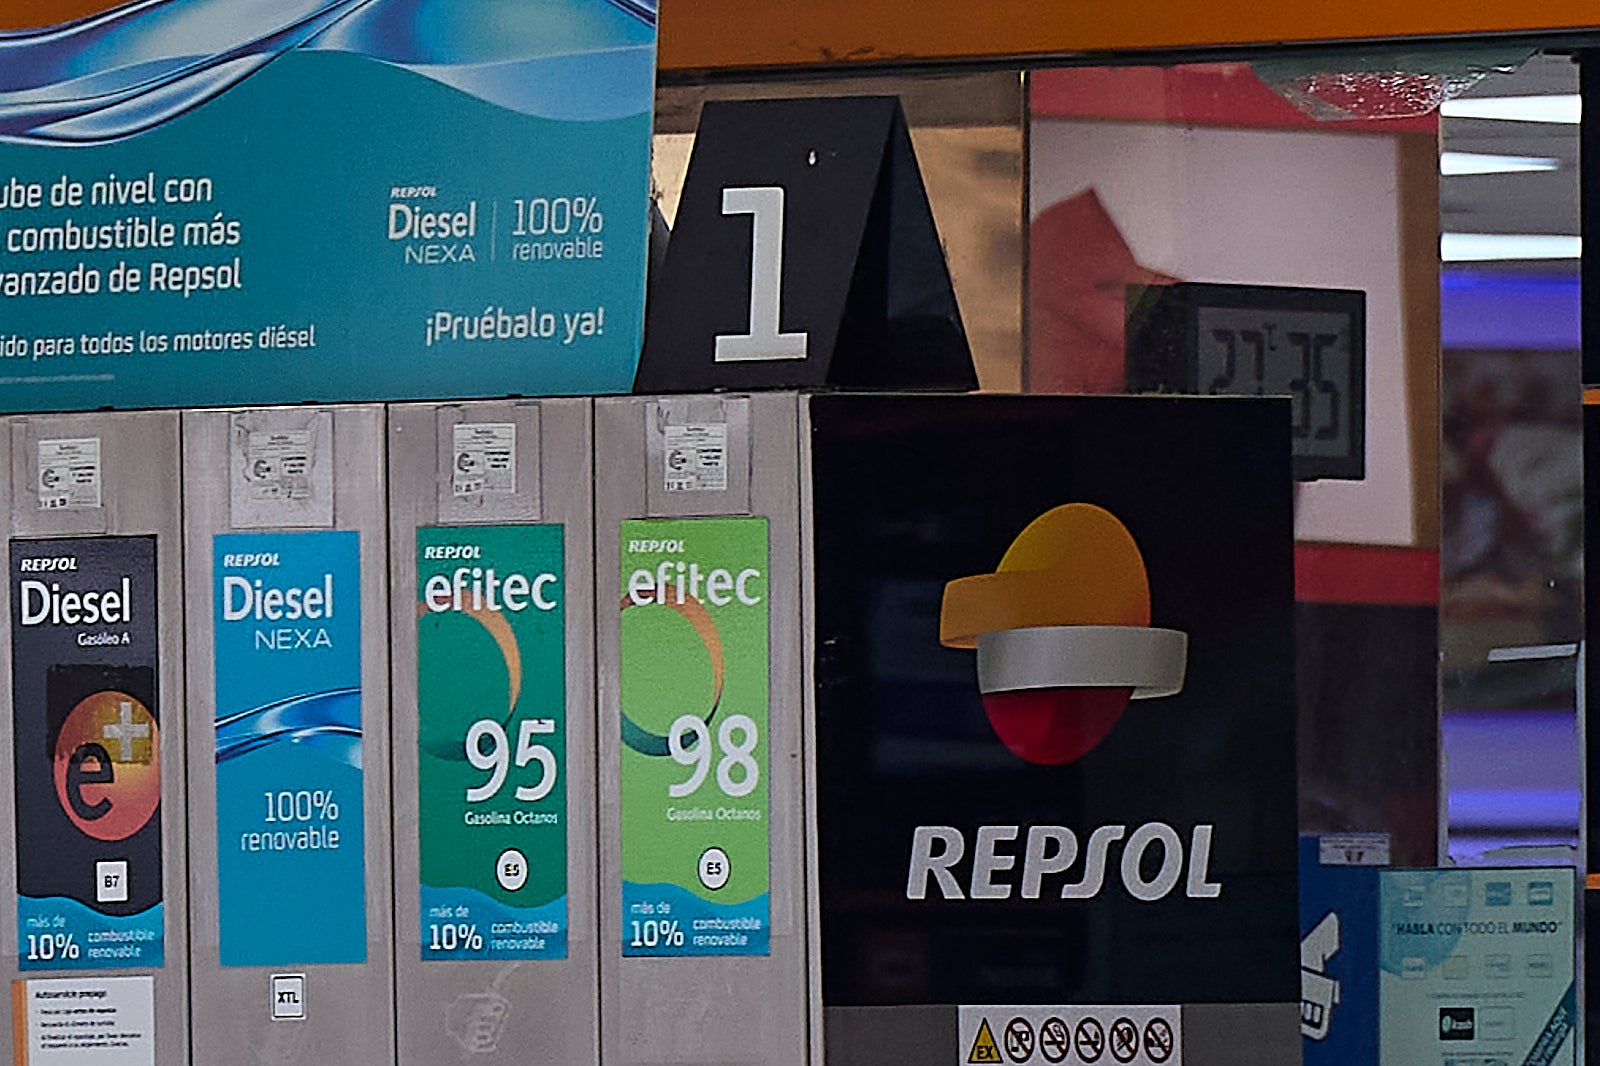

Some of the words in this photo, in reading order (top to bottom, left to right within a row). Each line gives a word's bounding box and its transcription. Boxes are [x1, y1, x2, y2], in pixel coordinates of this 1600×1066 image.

[50, 174, 83, 207] de
[91, 172, 156, 206] nivel
[163, 177, 213, 203] con
[390, 186, 438, 199] REPSOL
[388, 200, 477, 240] Diesel
[512, 196, 604, 236] 100%
[7, 216, 175, 252] combustible
[183, 212, 241, 246] más
[405, 243, 476, 264] NEXA
[512, 237, 603, 261] renovable
[109, 260, 141, 293] de
[150, 257, 242, 298] Repsol
[714, 186, 808, 362] 1
[426, 306, 556, 347] ¡Pruébalo
[563, 306, 605, 345] ya!
[32, 337, 75, 361] para
[80, 332, 134, 355] todos
[139, 330, 168, 353] los
[173, 329, 252, 352] motores
[258, 324, 316, 349] diésel
[424, 545, 482, 559] REPSOL
[628, 540, 686, 553] REPSOL
[20, 557, 78, 572] REPSOL
[223, 552, 280, 568] REPSOL
[424, 567, 557, 612] efitec
[628, 561, 761, 607] efitec
[21, 577, 130, 625] Diesel
[223, 573, 333, 621] Diesel
[121, 631, 130, 644] A
[255, 628, 332, 650] NEXA
[465, 718, 558, 802] 95
[668, 714, 760, 798] 98
[264, 790, 339, 822] 100%
[666, 807, 713, 822] Gasolina
[715, 807, 761, 821] Octanos
[464, 811, 511, 825] Gasolina
[513, 810, 558, 825] Octanos
[241, 825, 339, 851] renovable
[706, 862, 722, 875] E5
[906, 821, 1222, 901] REPSOL
[103, 875, 120, 889] B7
[429, 905, 453, 918] más
[455, 905, 469, 918] de
[630, 902, 654, 914] más
[656, 901, 671, 914] de
[26, 914, 50, 928] más
[53, 915, 66, 928] de
[491, 920, 558, 934] combustible
[692, 917, 761, 931] combustible
[1437, 922, 1460, 936] CON
[1461, 921, 1495, 935] TODO
[1498, 921, 1510, 934] EL
[87, 929, 155, 943] combustible
[429, 923, 483, 951] 10%
[491, 937, 545, 951] renovable
[630, 919, 685, 947] 10%
[692, 933, 748, 947] renovable
[27, 933, 80, 960] 10%
[87, 945, 141, 958] renovable
